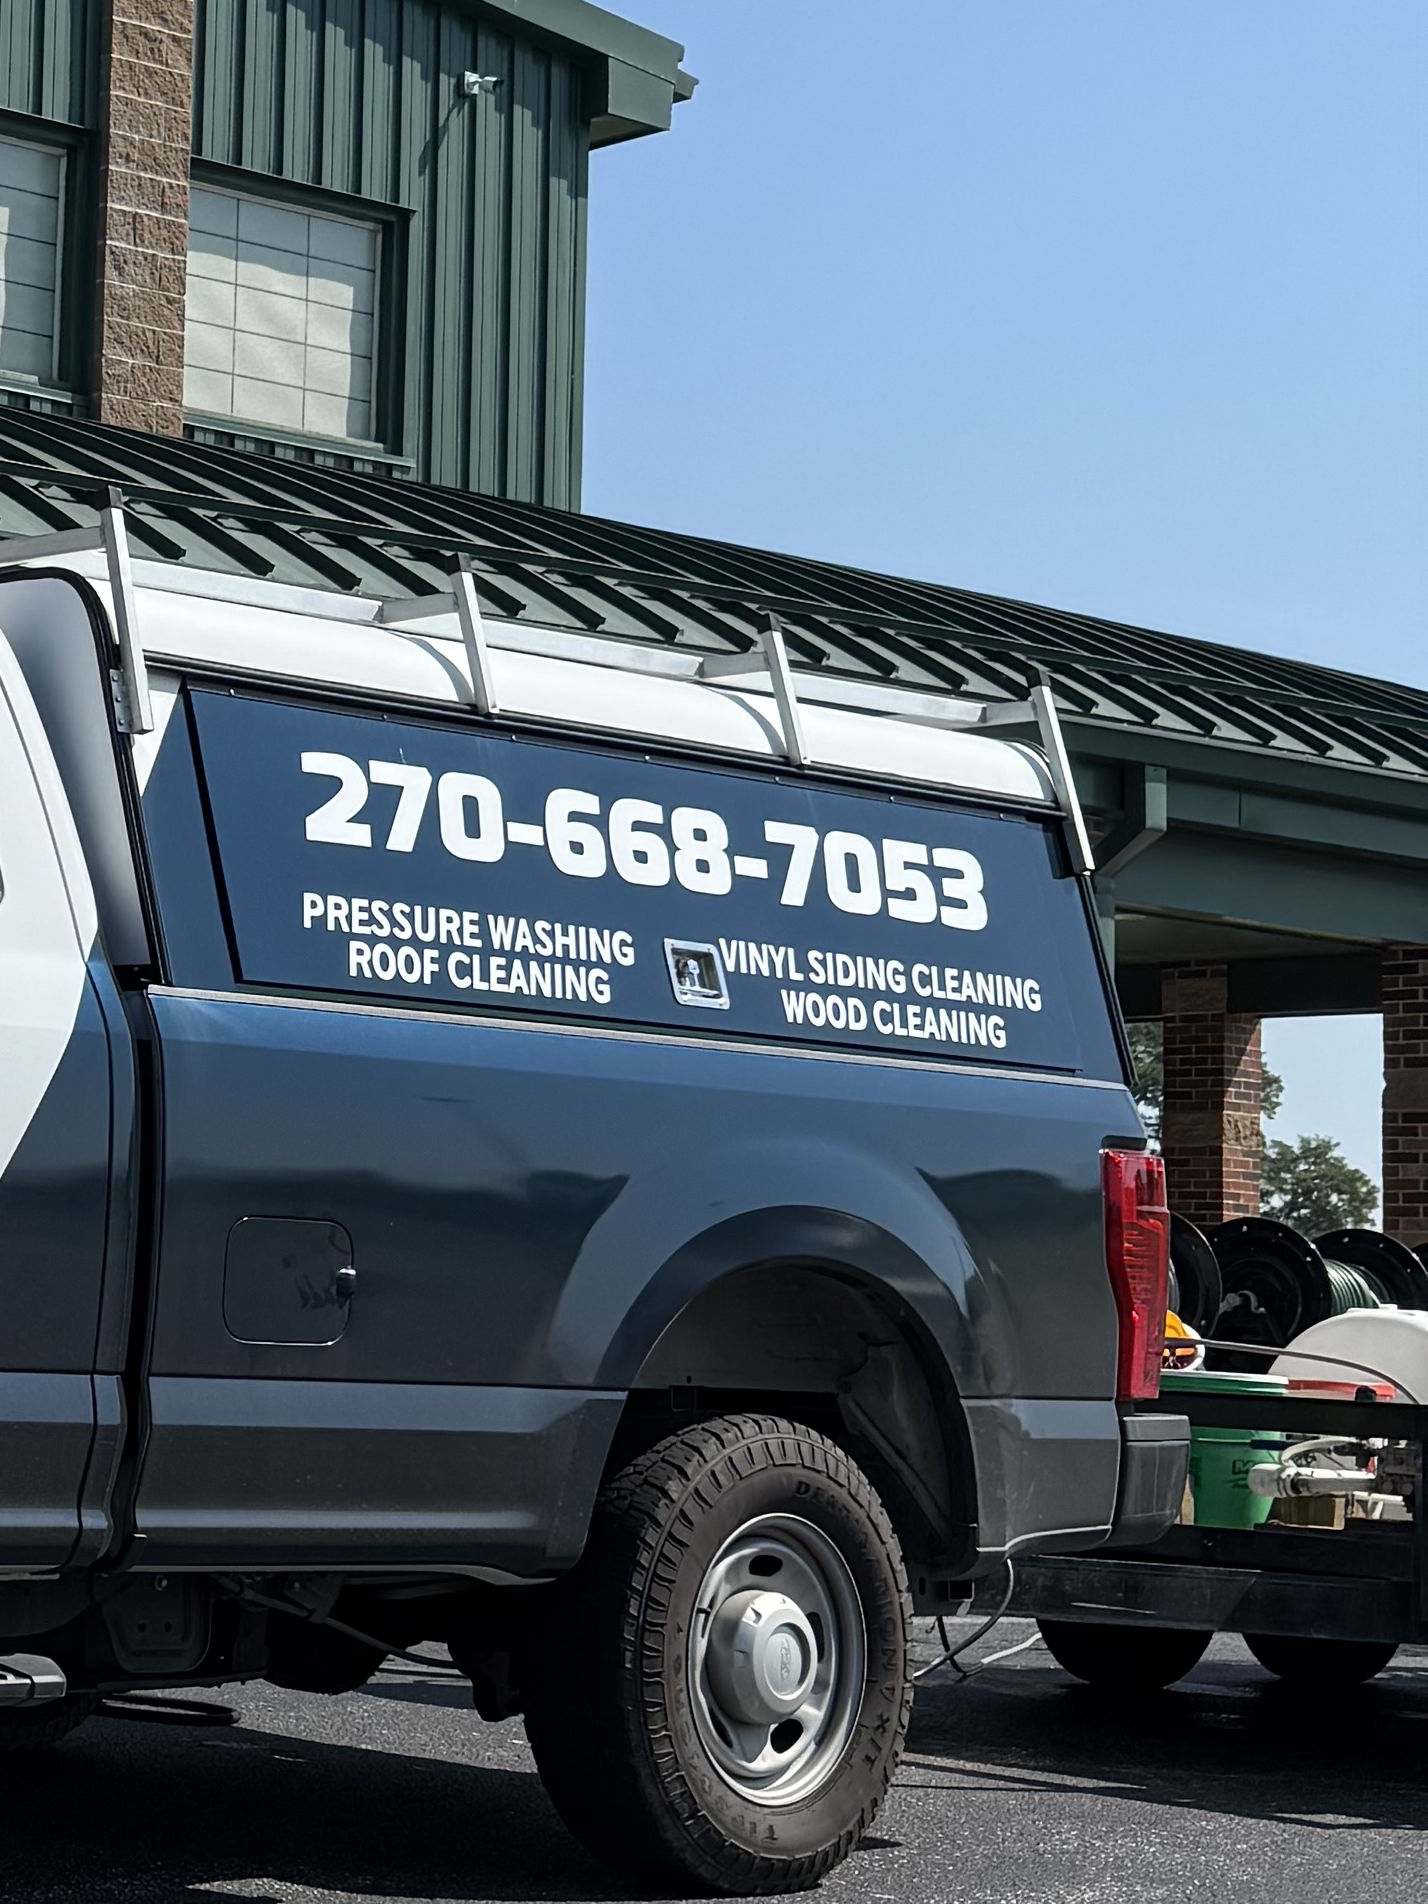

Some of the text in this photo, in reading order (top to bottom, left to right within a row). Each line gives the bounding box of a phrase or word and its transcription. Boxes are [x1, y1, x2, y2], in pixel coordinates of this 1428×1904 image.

[300, 751, 990, 931] 270-668-7053
[302, 892, 636, 967] PRESSURE WASHING
[348, 939, 612, 1005] ROOF CLEANING
[719, 938, 1043, 1013] VINYL SIDING CLEANING
[781, 989, 1008, 1049] WOOD CLEANING
